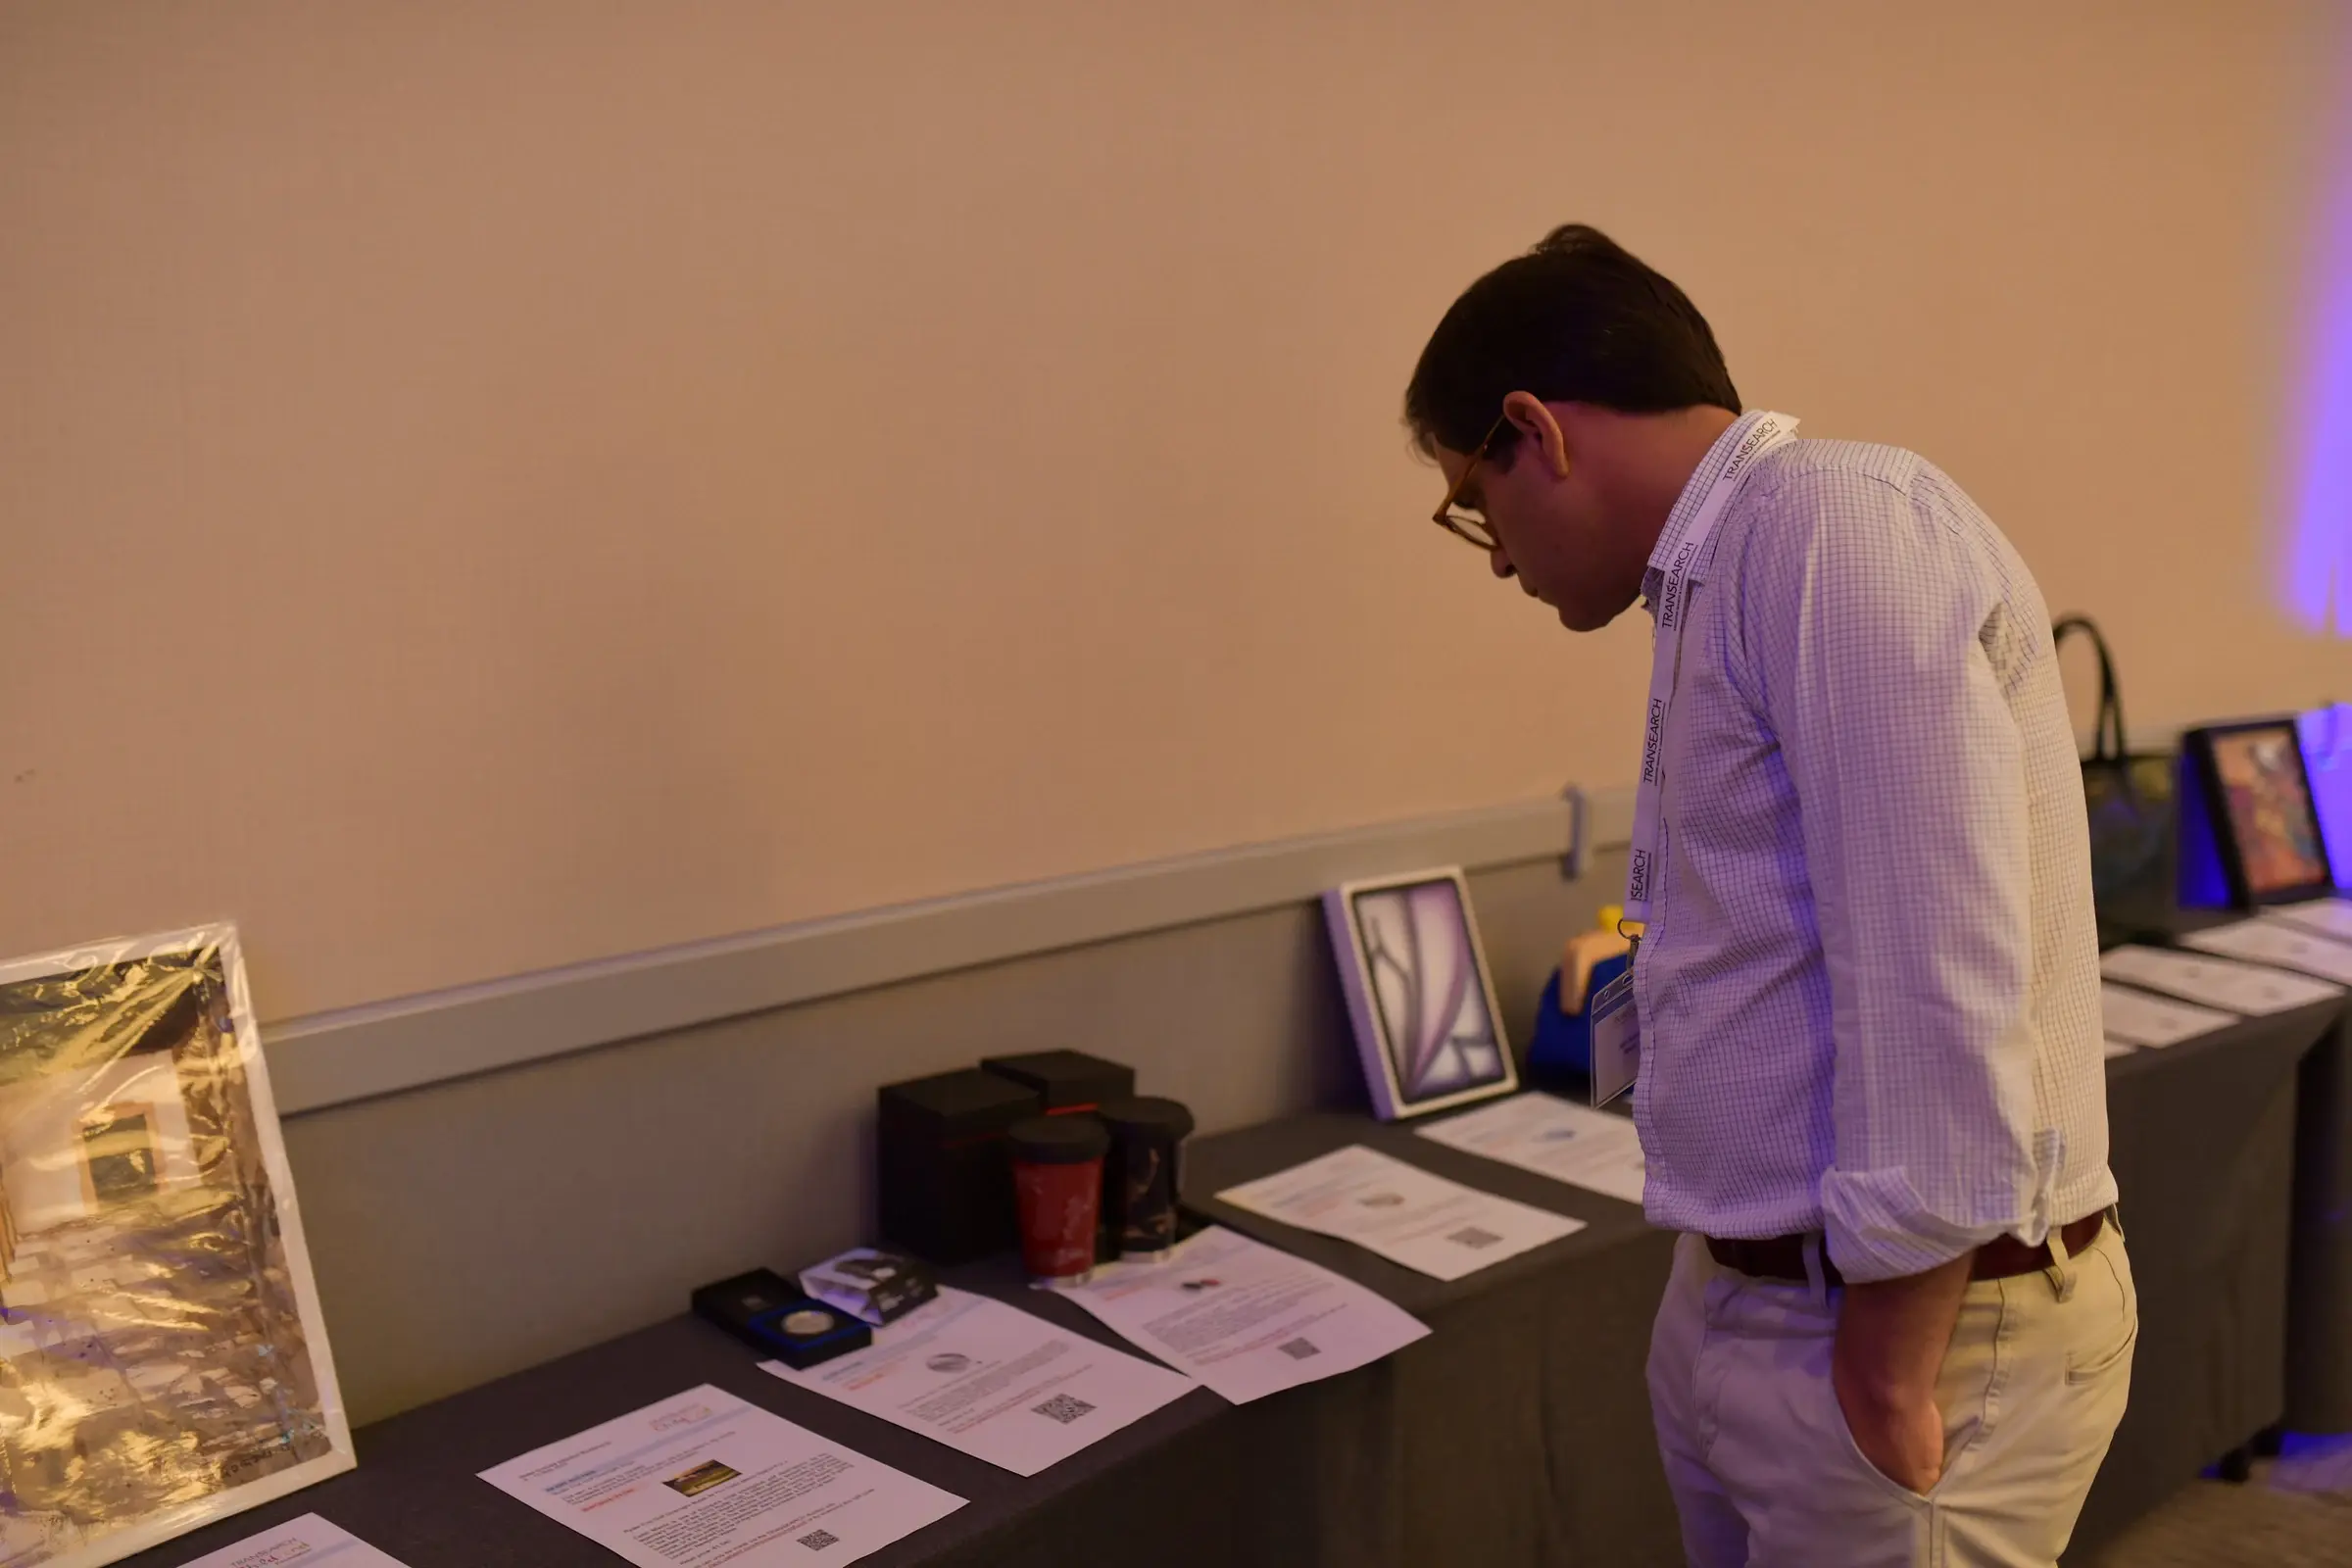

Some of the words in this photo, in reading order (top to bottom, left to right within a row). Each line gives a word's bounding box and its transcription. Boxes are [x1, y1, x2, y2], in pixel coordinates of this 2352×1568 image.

[1723, 418, 1778, 480] TRANSEARCH
[1662, 542, 1694, 628] TRANSEARCH
[1643, 698, 1663, 783] TRANSEARCH
